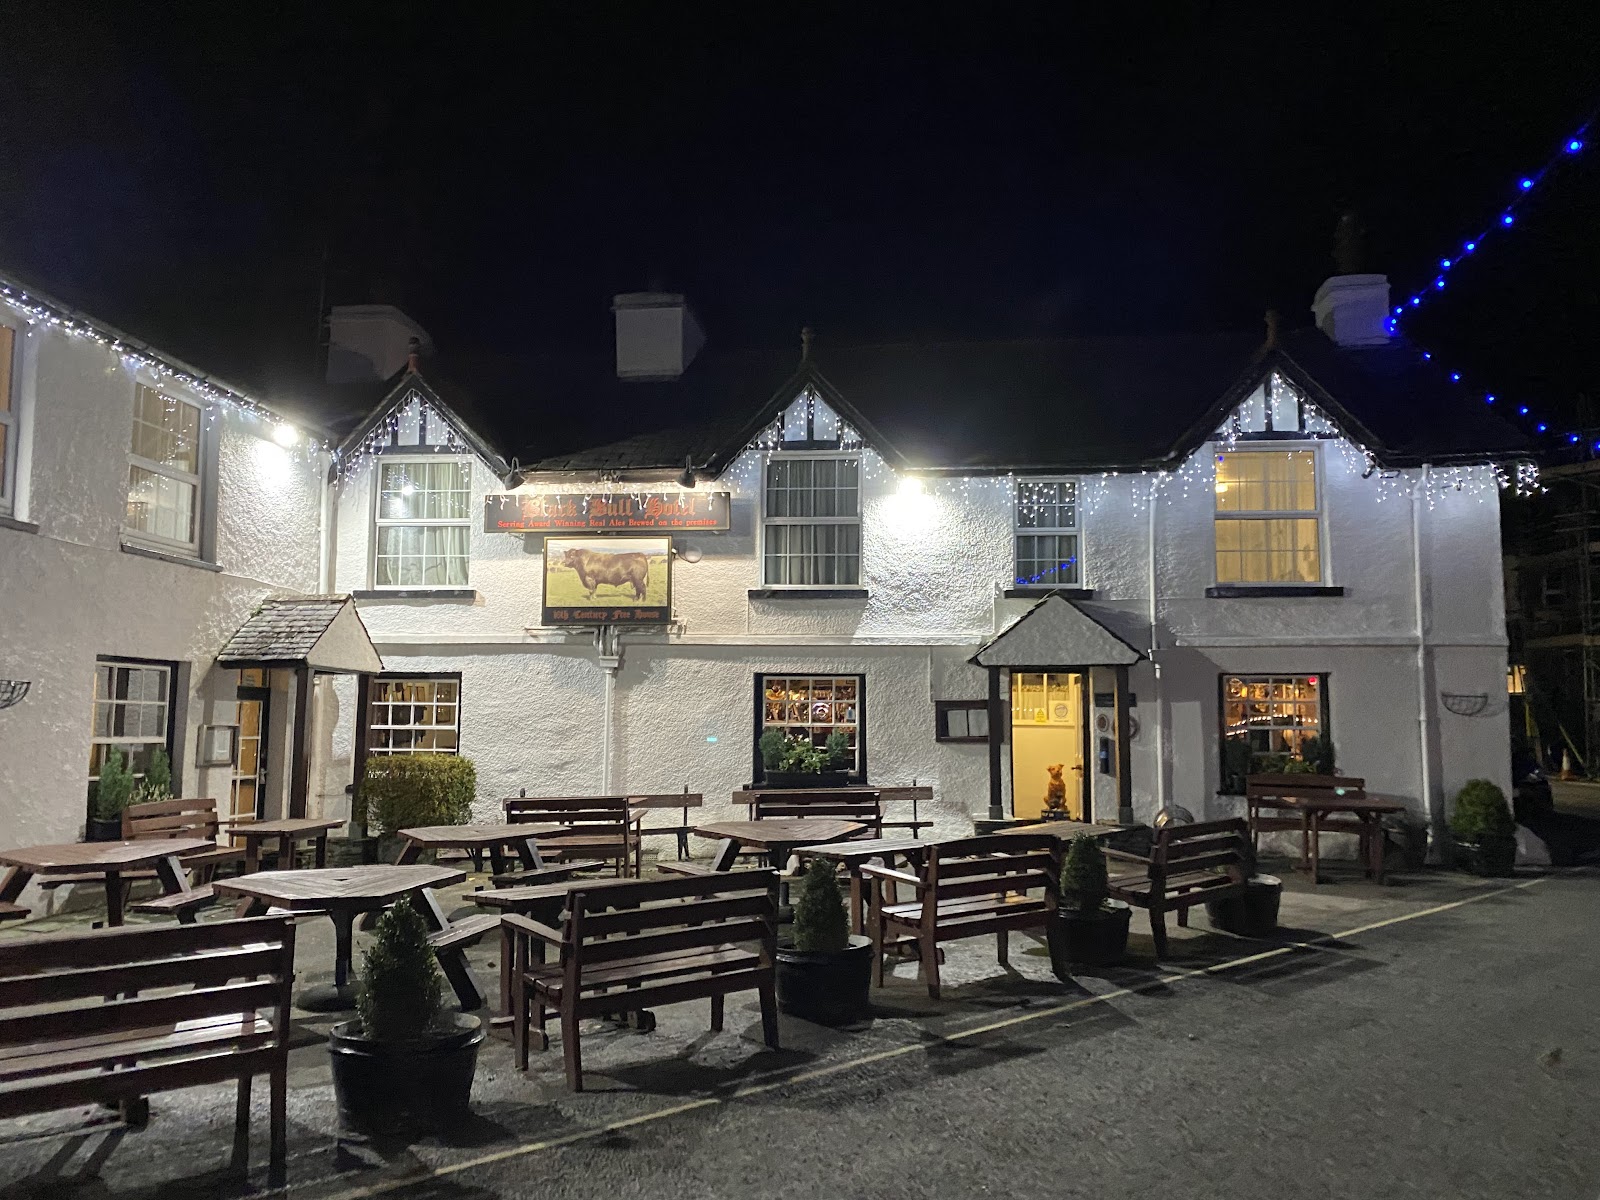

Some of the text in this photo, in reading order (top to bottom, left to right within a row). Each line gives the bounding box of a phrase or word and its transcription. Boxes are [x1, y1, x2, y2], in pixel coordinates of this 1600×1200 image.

[589, 498, 633, 519] Bull
[644, 497, 696, 519] Hotel
[498, 520, 525, 528] Serving
[554, 520, 585, 528] Winning
[686, 519, 717, 527] premises
[573, 610, 608, 620] Century
[612, 610, 631, 619] Free
[634, 610, 660, 619] House
